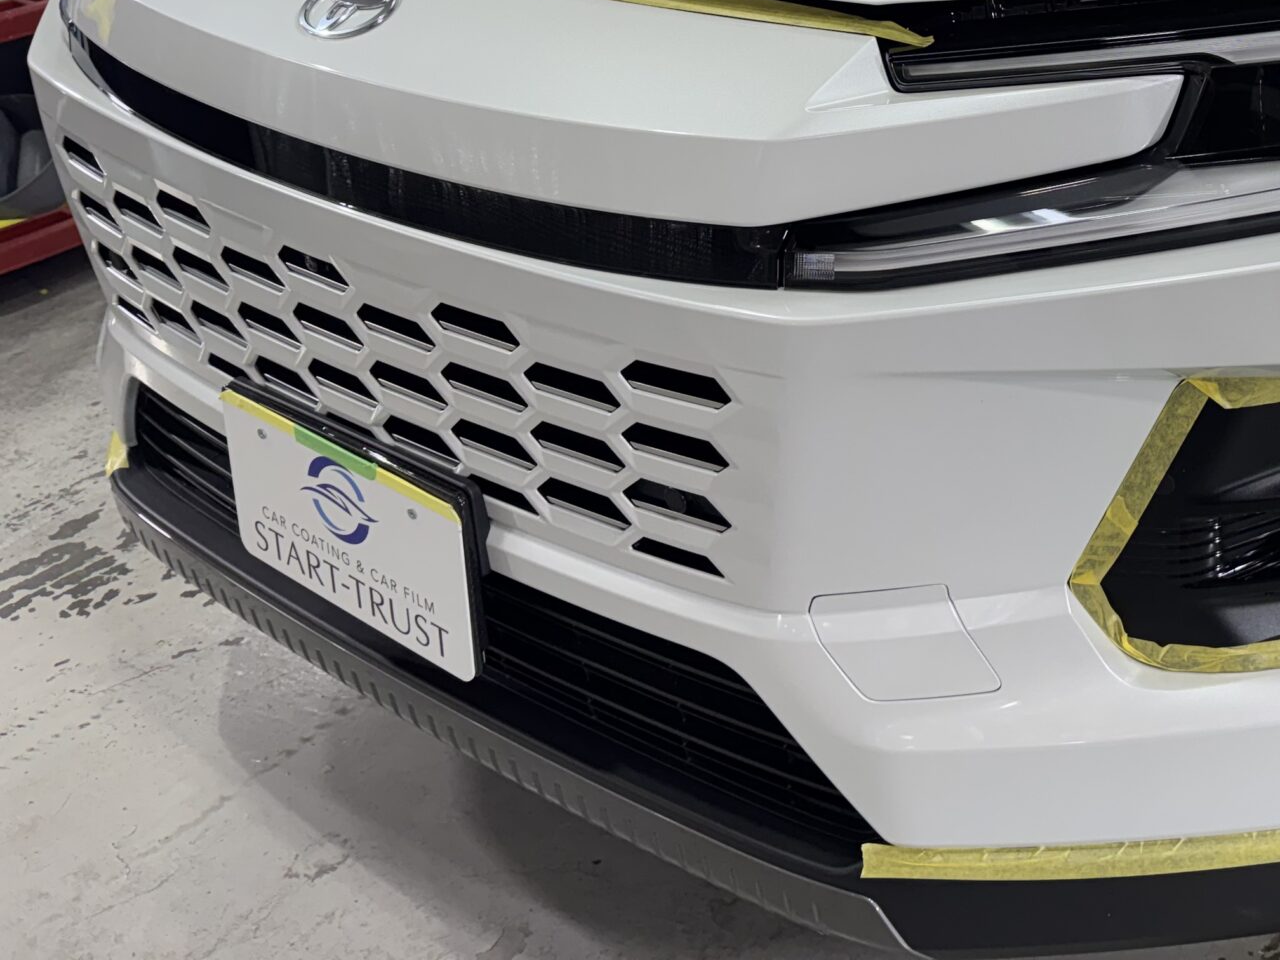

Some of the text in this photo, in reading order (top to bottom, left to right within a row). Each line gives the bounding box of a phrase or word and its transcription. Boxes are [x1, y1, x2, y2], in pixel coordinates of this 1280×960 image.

[255, 520, 449, 658] START-TRUST
[262, 505, 435, 615] CAR COATING & CAR FILM
